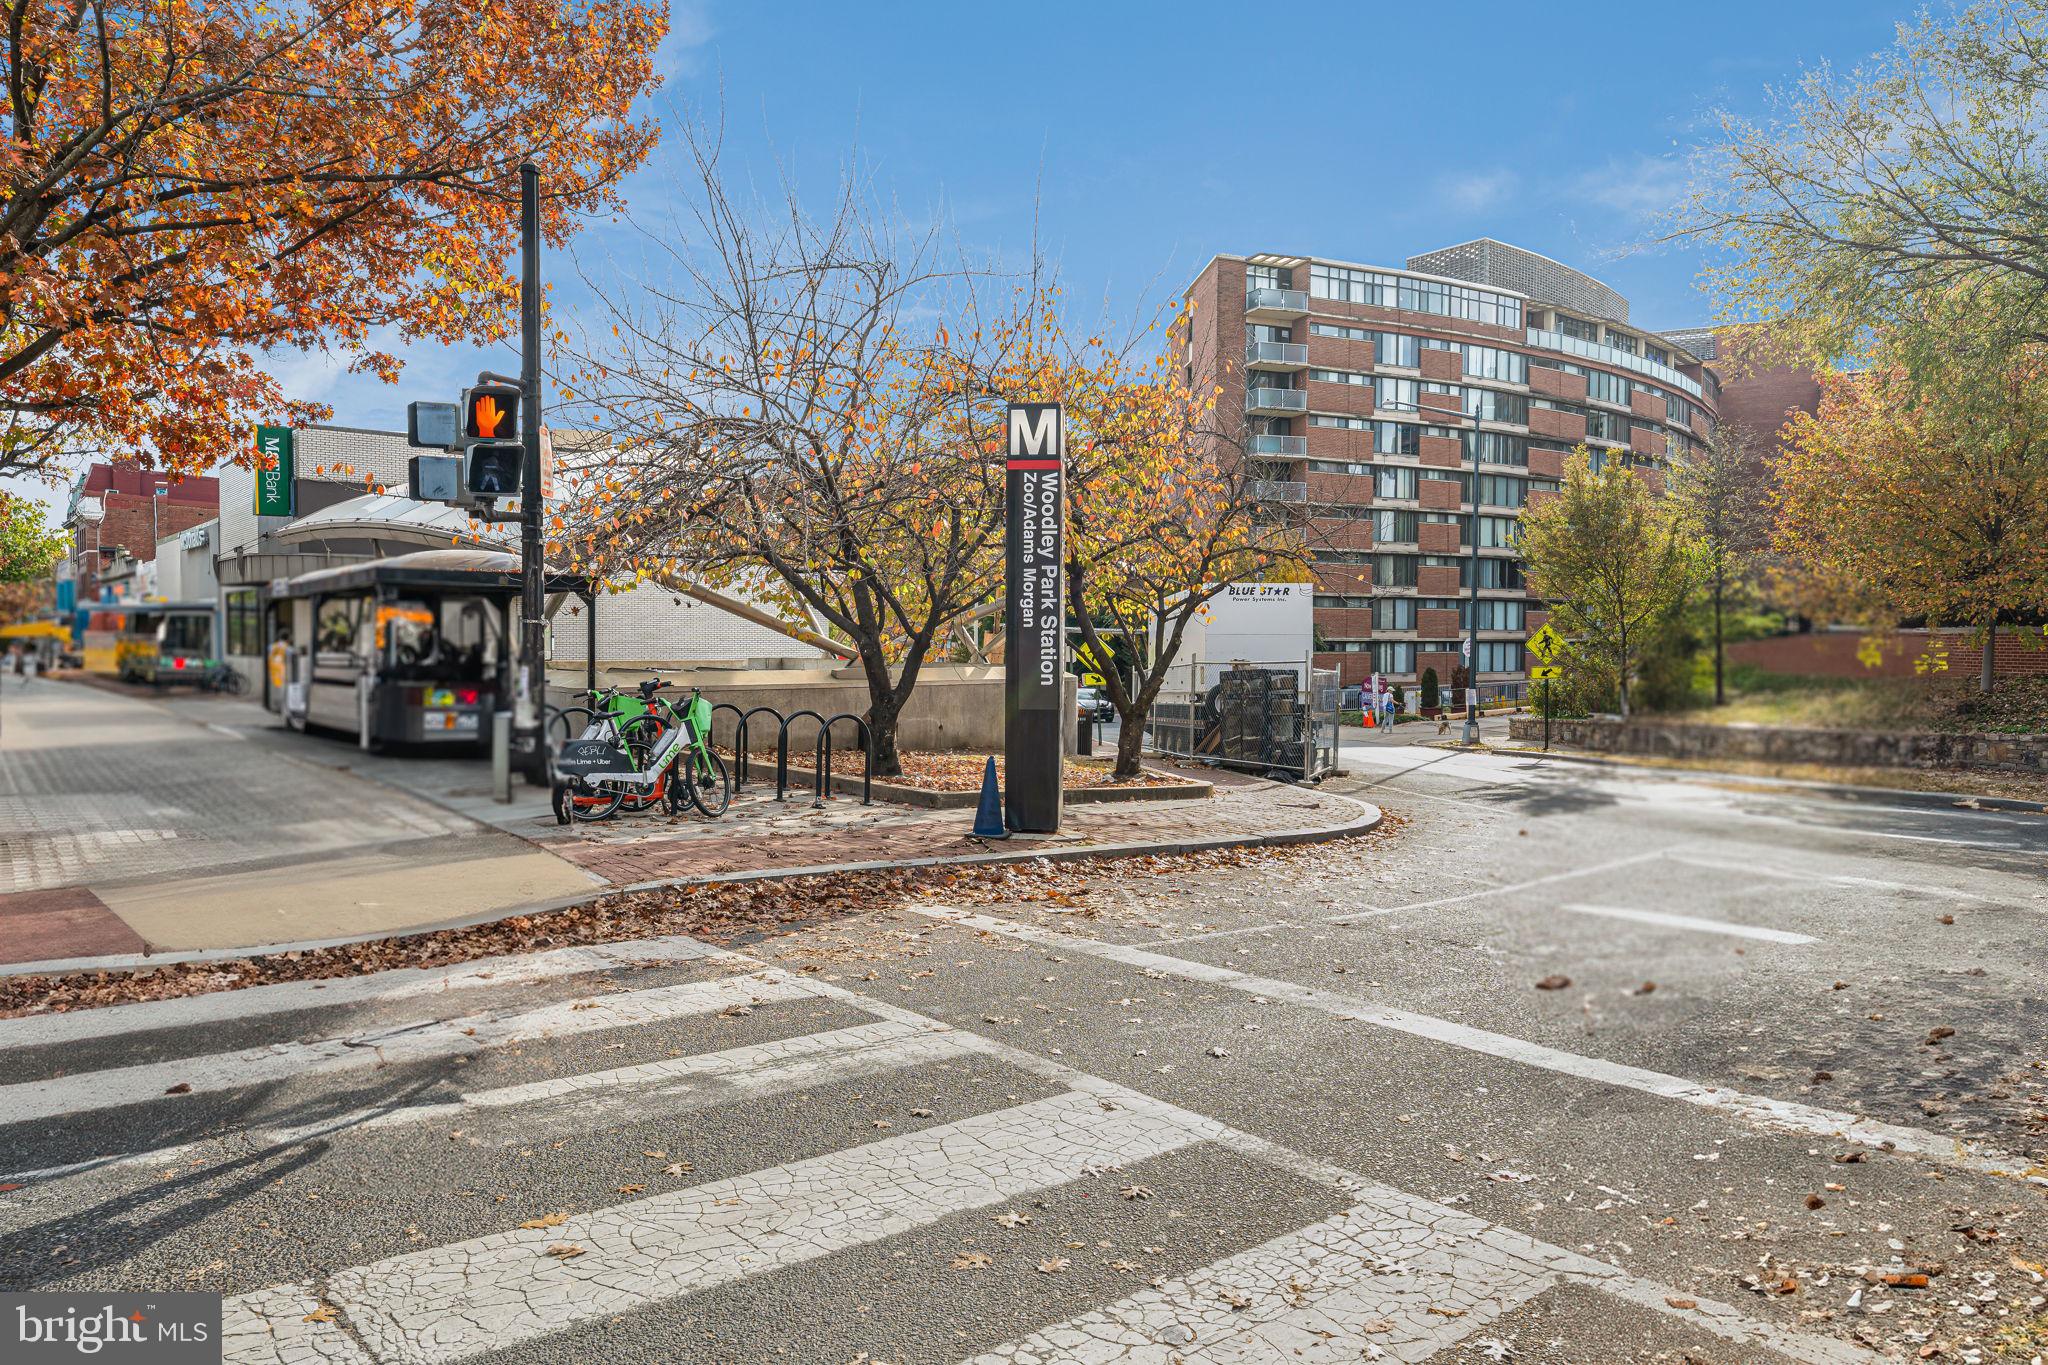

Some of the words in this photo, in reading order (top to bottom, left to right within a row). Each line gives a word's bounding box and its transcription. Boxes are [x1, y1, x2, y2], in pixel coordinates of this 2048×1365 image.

[1010, 409, 1057, 455] M
[265, 471, 281, 503] Bank
[1023, 472, 1037, 564] Zoo/Adams
[1037, 472, 1058, 559] Woodley
[1020, 568, 1037, 628] Morgan
[1041, 565, 1058, 610] Park
[1229, 586, 1256, 596] BLUE
[1040, 615, 1058, 686] Station
[659, 743, 680, 770] Lime
